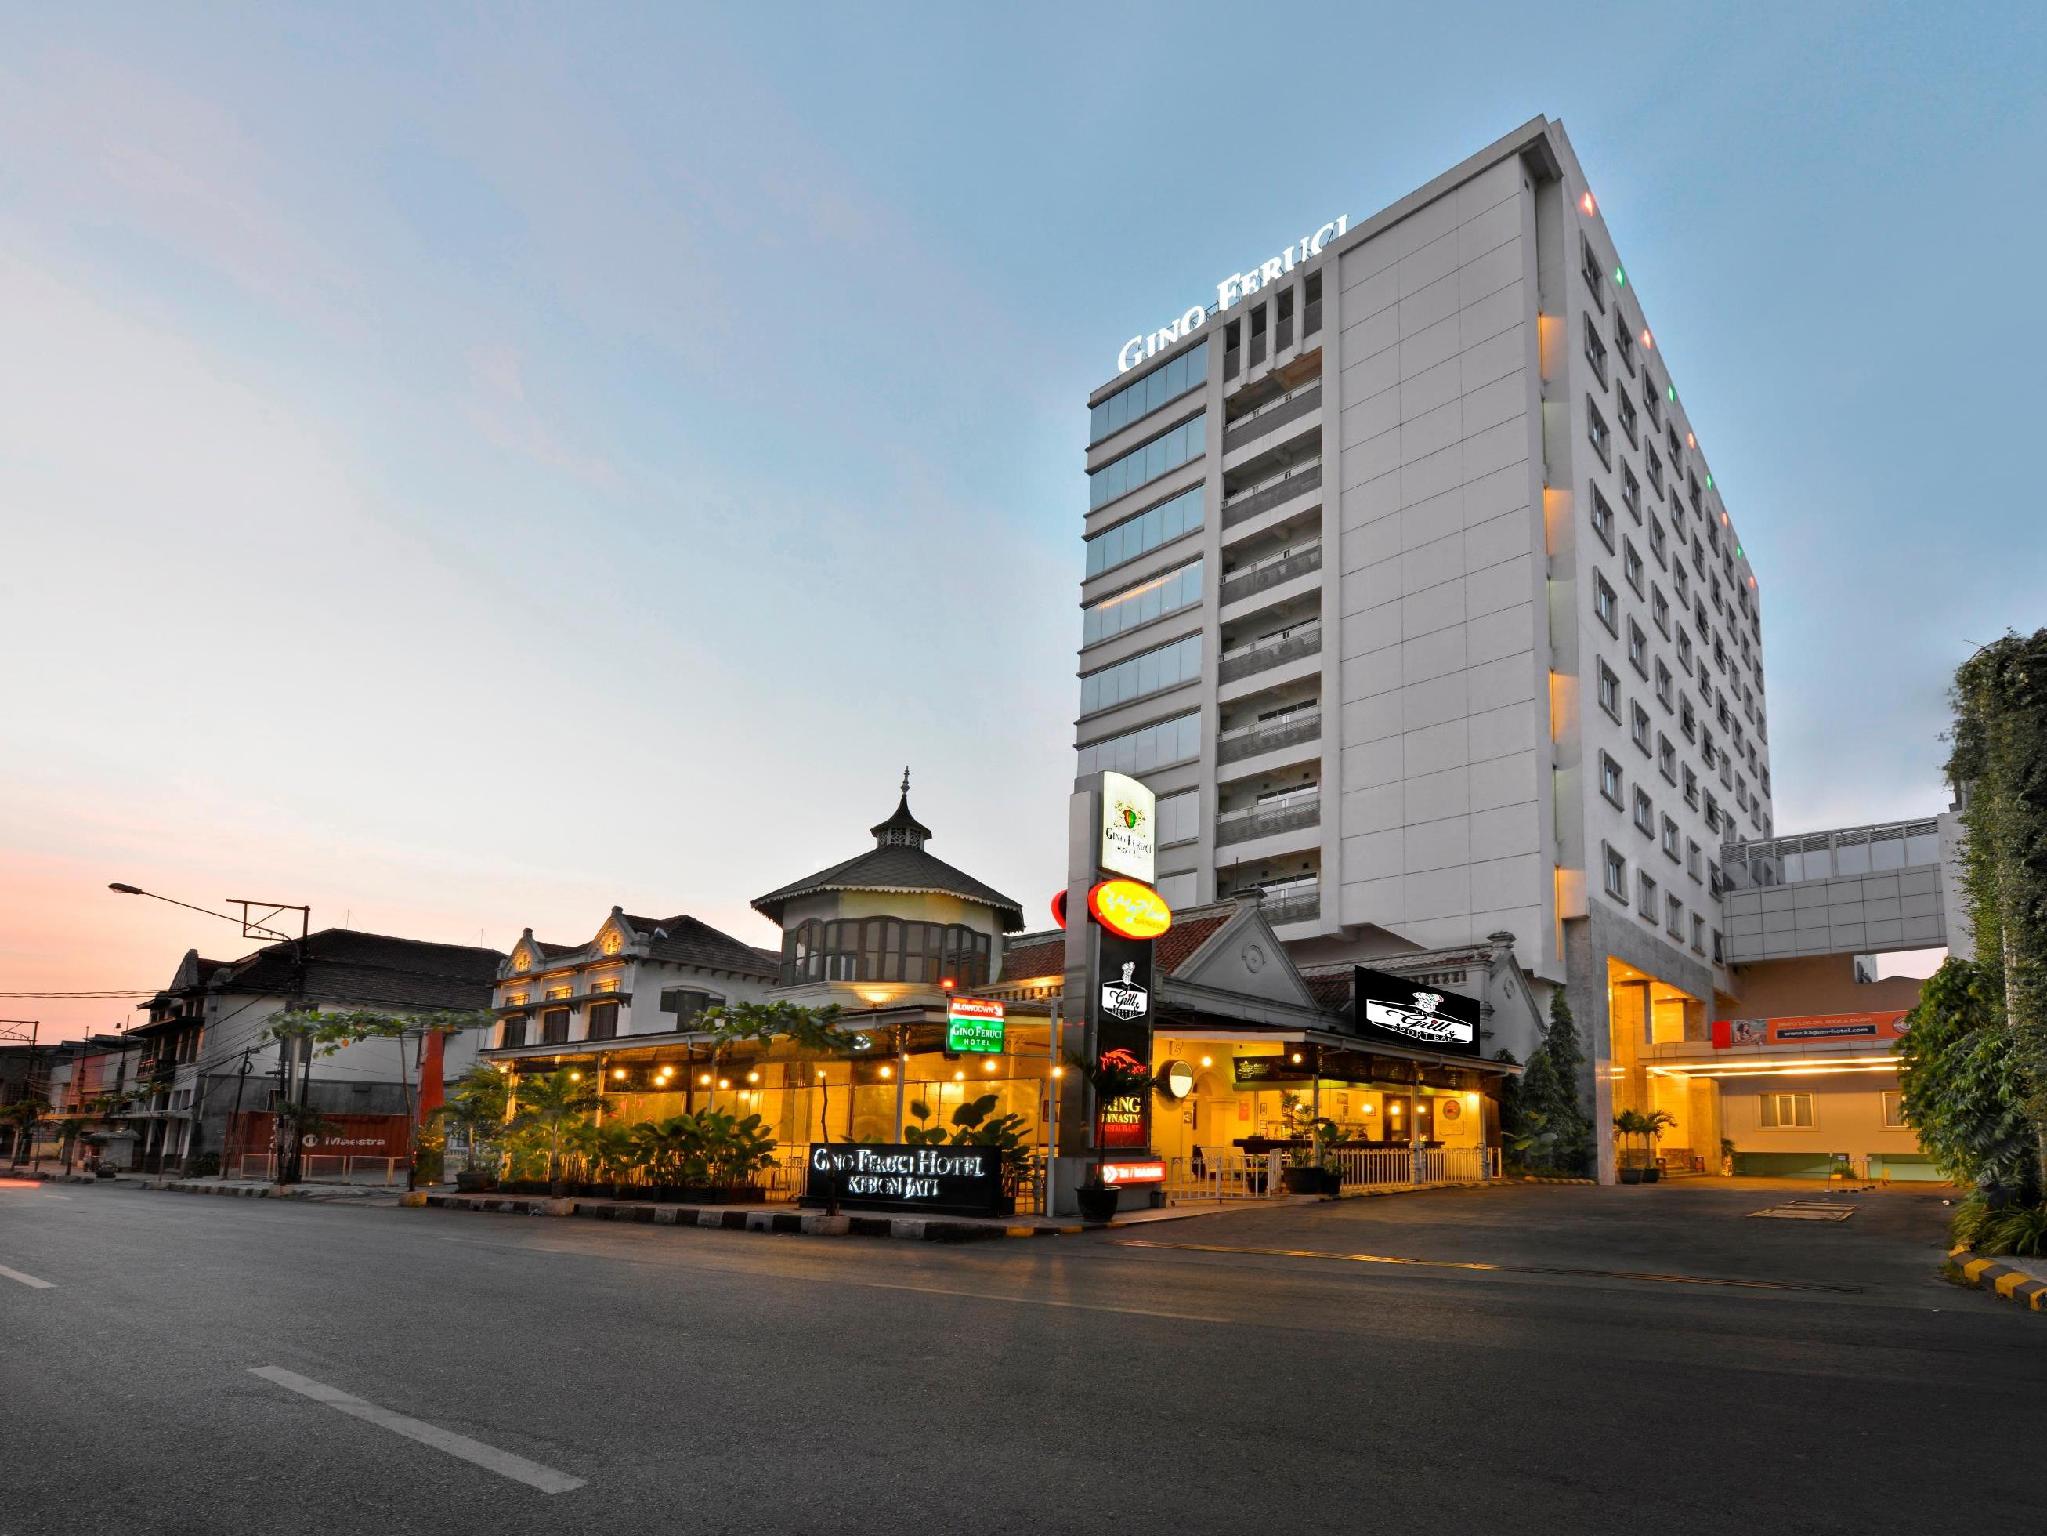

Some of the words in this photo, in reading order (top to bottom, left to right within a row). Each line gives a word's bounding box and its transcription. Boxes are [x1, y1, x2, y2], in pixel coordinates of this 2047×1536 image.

[1118, 305, 1207, 371] GINO
[1216, 213, 1350, 311] FERUCI
[952, 1024, 974, 1037] GINO
[976, 1026, 1002, 1039] FERUCI
[1104, 1096, 1141, 1113] ING
[814, 1148, 854, 1171] GNO
[917, 1150, 985, 1177] HOTEL
